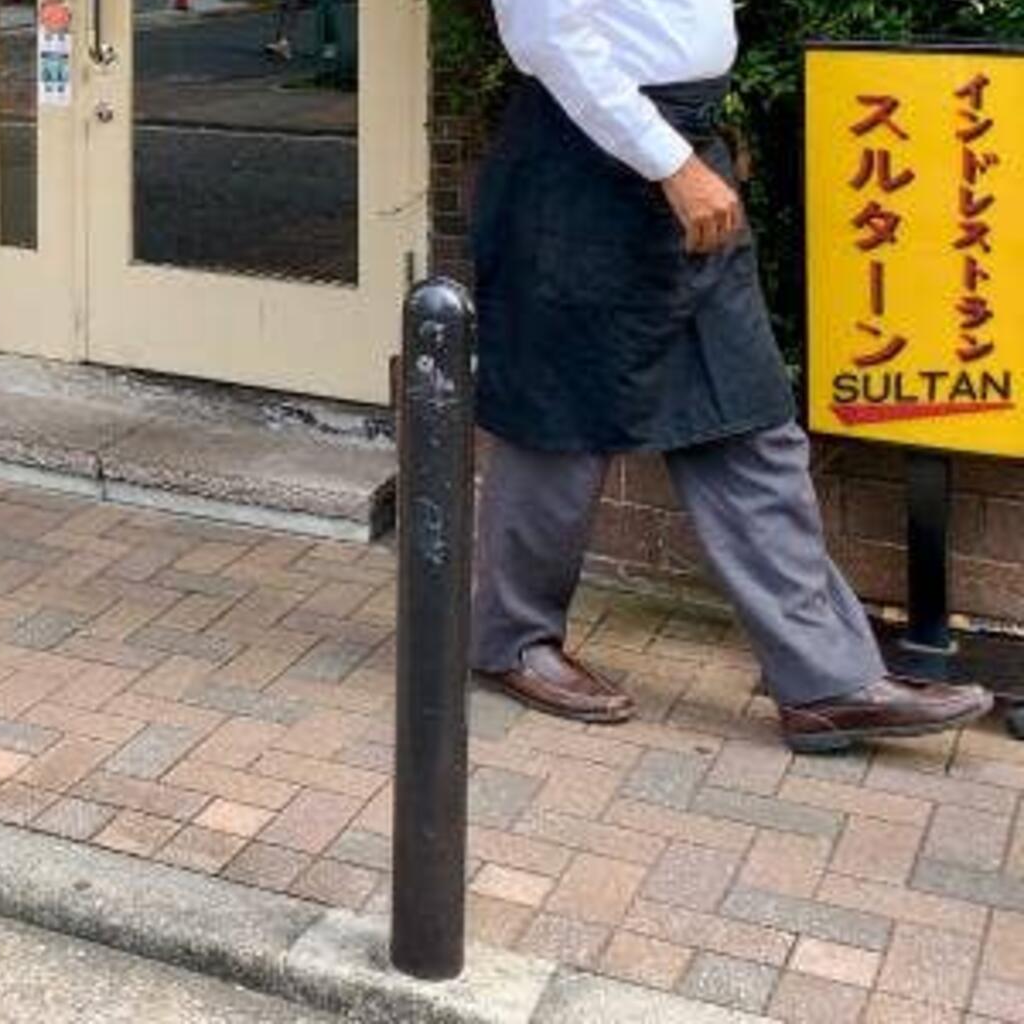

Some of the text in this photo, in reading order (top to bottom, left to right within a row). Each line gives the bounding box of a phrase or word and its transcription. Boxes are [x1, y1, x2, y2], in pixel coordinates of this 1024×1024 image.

[849, 94, 916, 368] スルターン
[952, 72, 1000, 363] インドレストラン
[831, 371, 1012, 404] SULTAN
